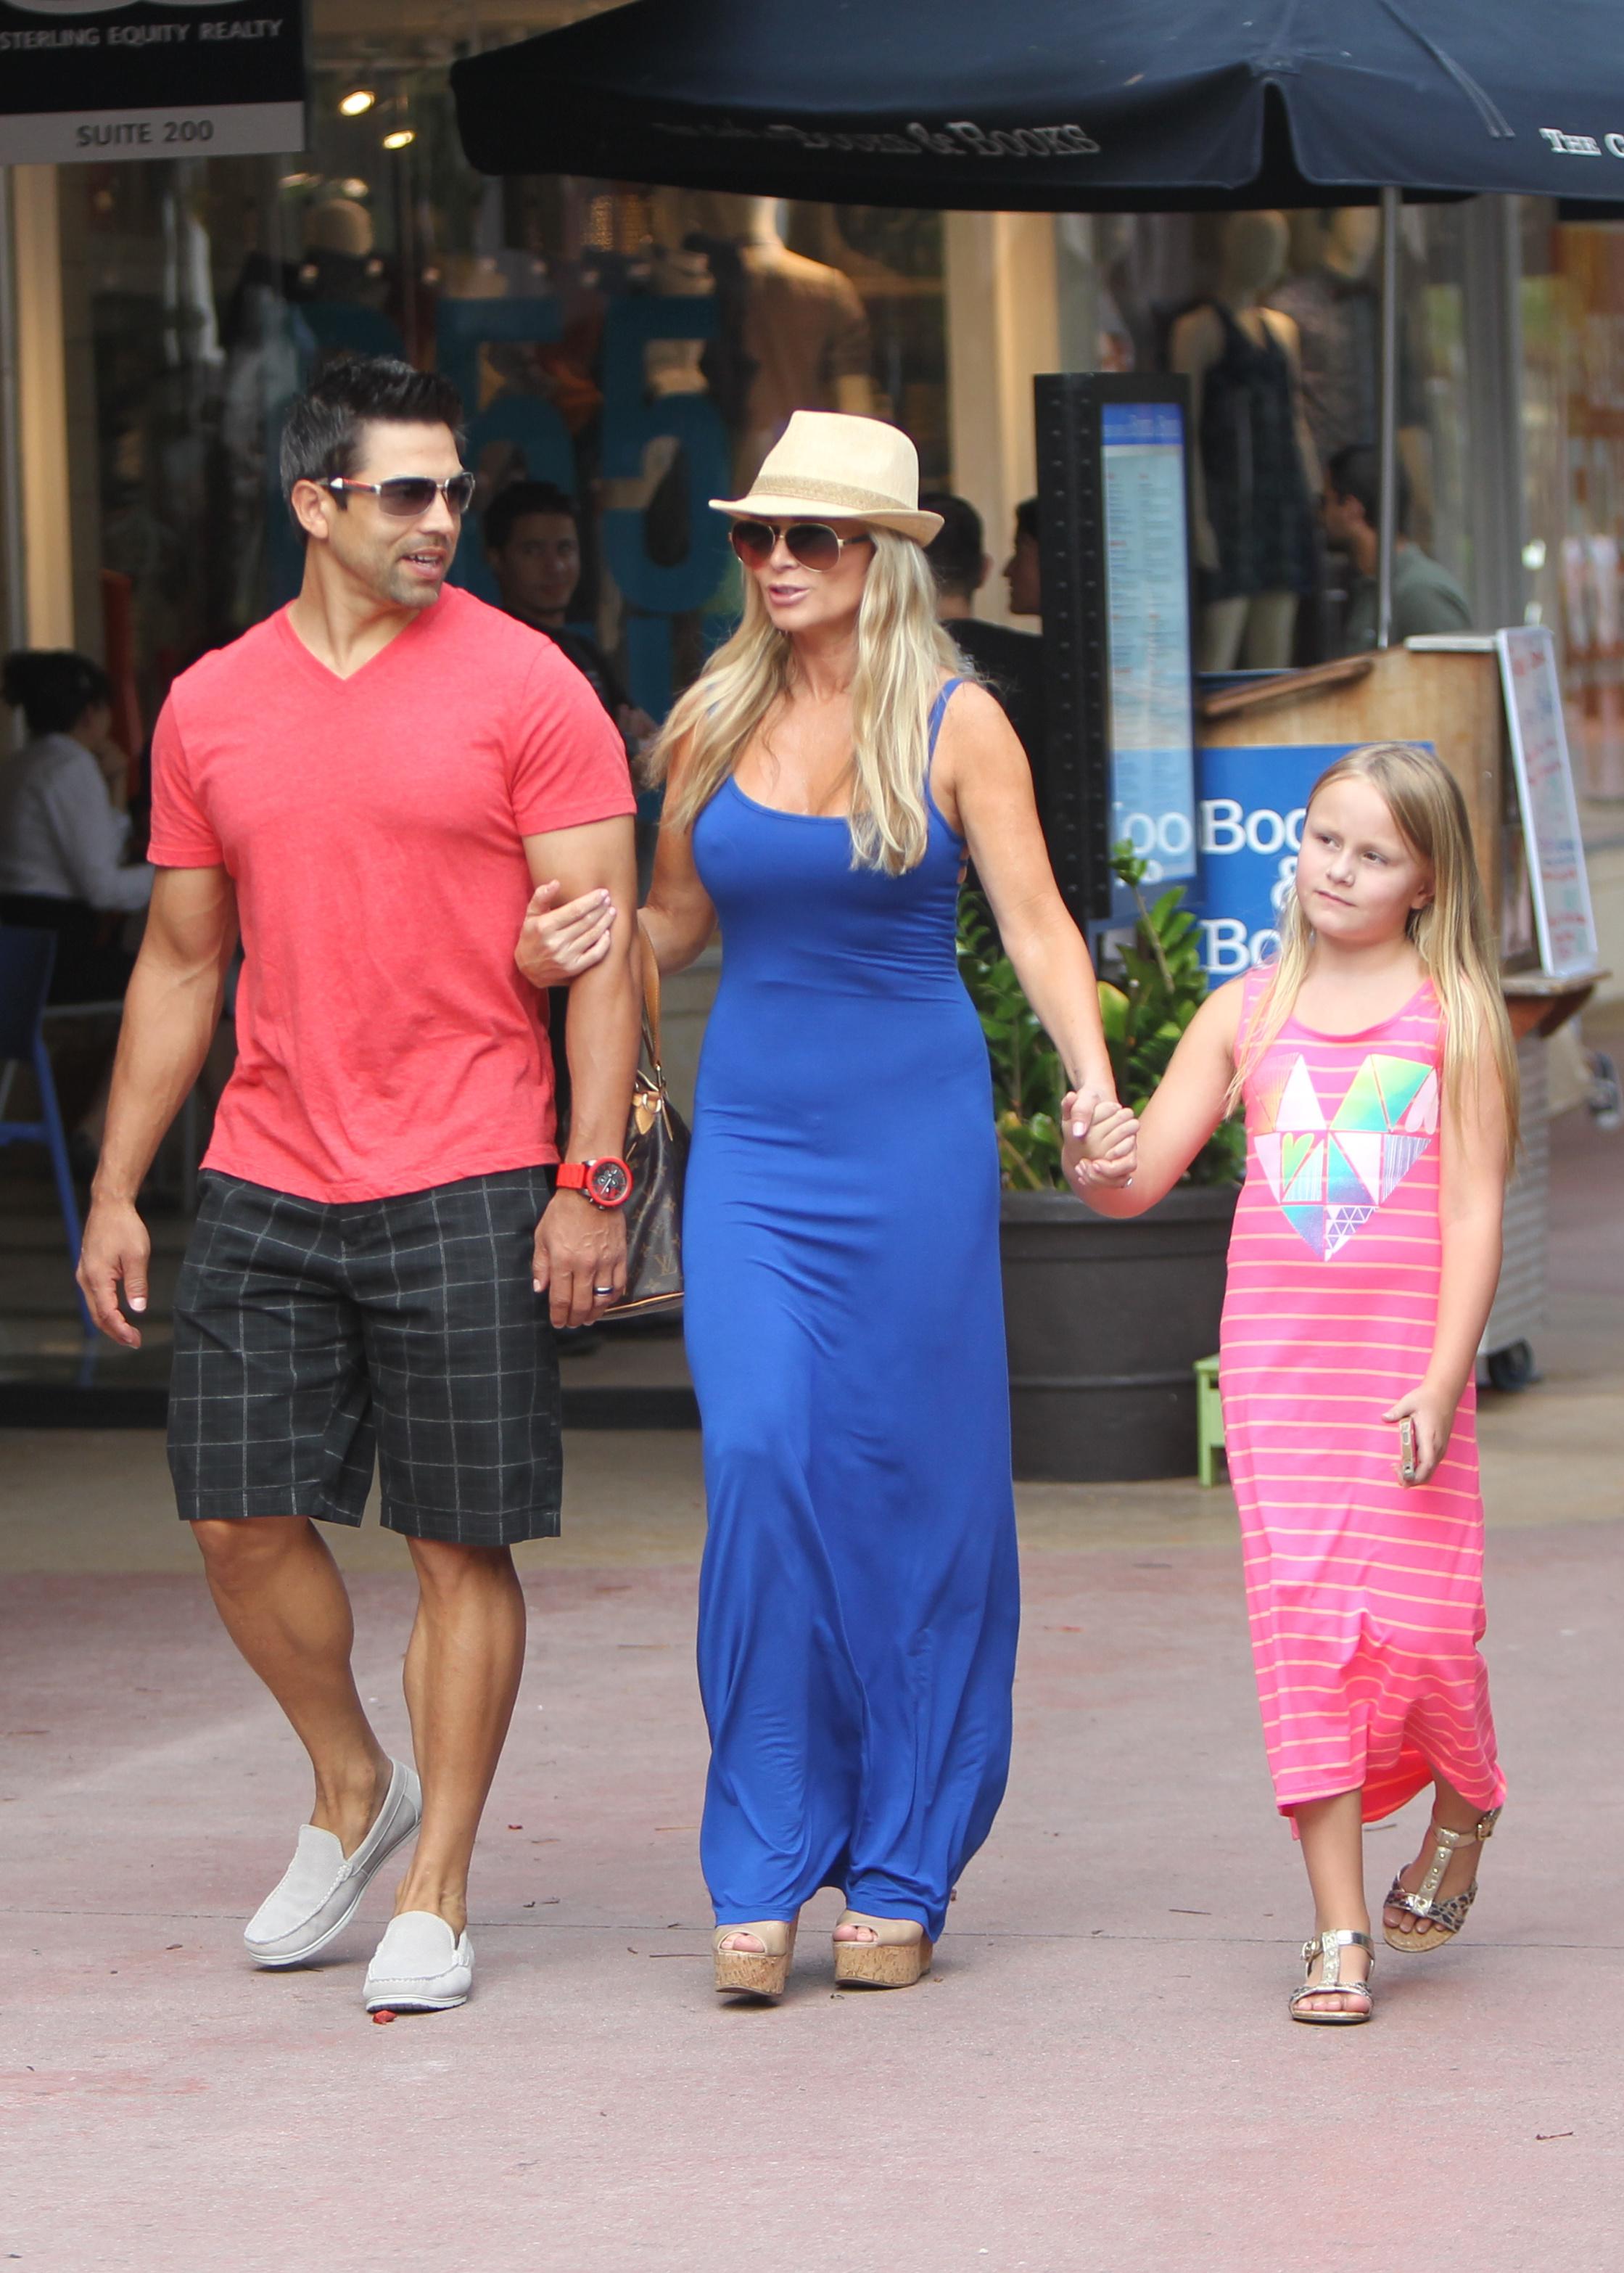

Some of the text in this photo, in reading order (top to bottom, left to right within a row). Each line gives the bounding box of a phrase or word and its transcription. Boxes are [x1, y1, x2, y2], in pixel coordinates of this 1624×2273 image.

[0, 18, 284, 50] STERLING EQUITY REALTY
[75, 119, 215, 147] SUITE 200
